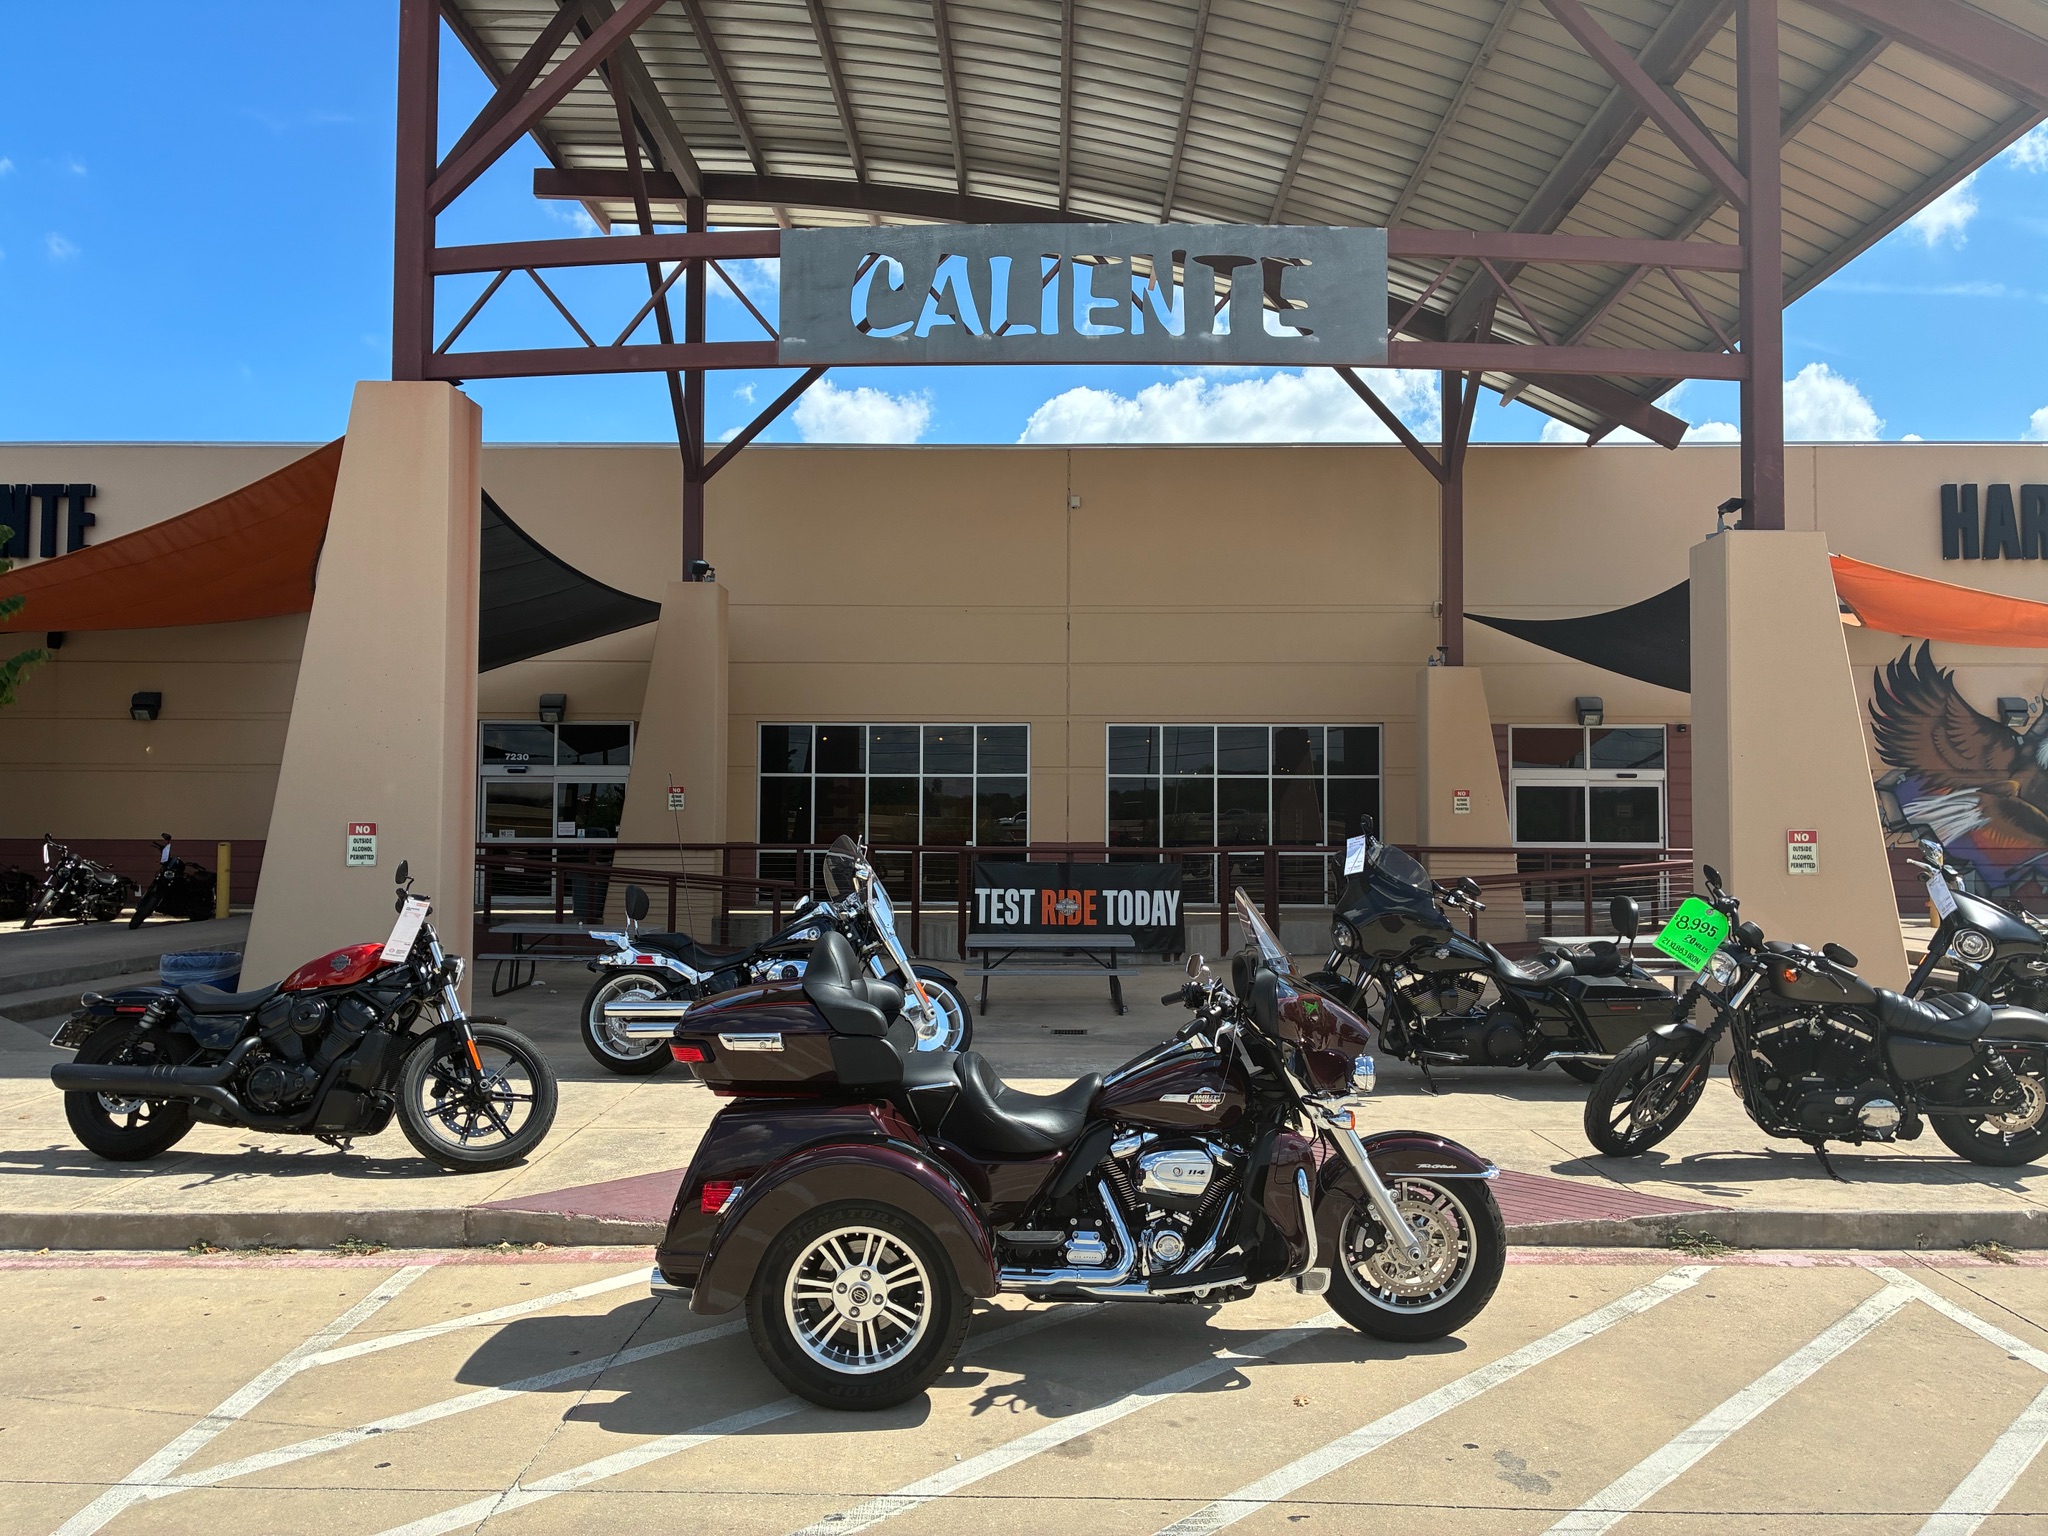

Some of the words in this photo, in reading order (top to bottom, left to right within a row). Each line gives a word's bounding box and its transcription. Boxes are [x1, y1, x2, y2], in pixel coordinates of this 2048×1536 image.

[851, 250, 1313, 338] CALIENTE
[1940, 483, 2048, 560] HAR
[505, 753, 530, 761] 7230
[355, 825, 370, 834] NO
[1794, 833, 1810, 842] NO
[975, 888, 1036, 925] TEST
[1041, 889, 1098, 926] RIDE
[1102, 890, 1181, 926] TODAY
[1683, 934, 1697, 945] 20
[1695, 942, 1709, 954] MILES
[1686, 952, 1702, 965] IRON
[784, 1208, 905, 1251] SIGNATURE
[828, 1370, 914, 1397] DUNLOP
